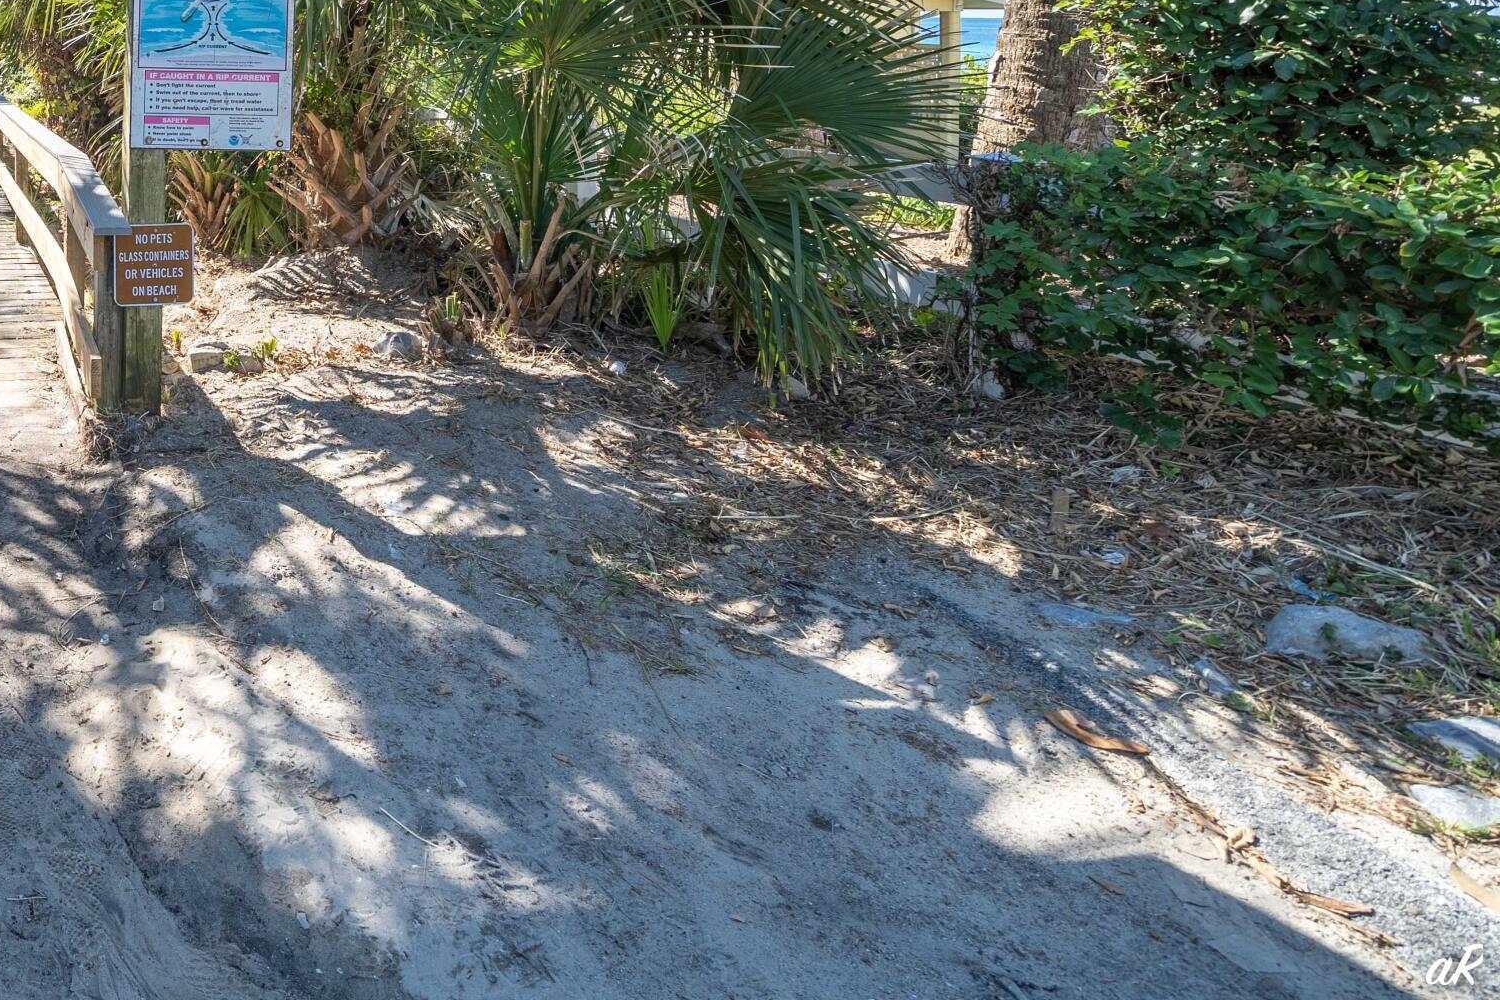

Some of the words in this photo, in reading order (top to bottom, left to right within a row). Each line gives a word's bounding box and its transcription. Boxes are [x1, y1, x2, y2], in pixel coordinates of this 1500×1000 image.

[135, 234, 148, 244] NO
[150, 233, 172, 244] PETS
[119, 251, 142, 262] GLASS
[144, 250, 189, 261] CONTAINERS
[125, 269, 137, 279] OR
[140, 268, 184, 279] VEHICLES
[132, 286, 145, 296] ON
[147, 285, 176, 296] BEACH
